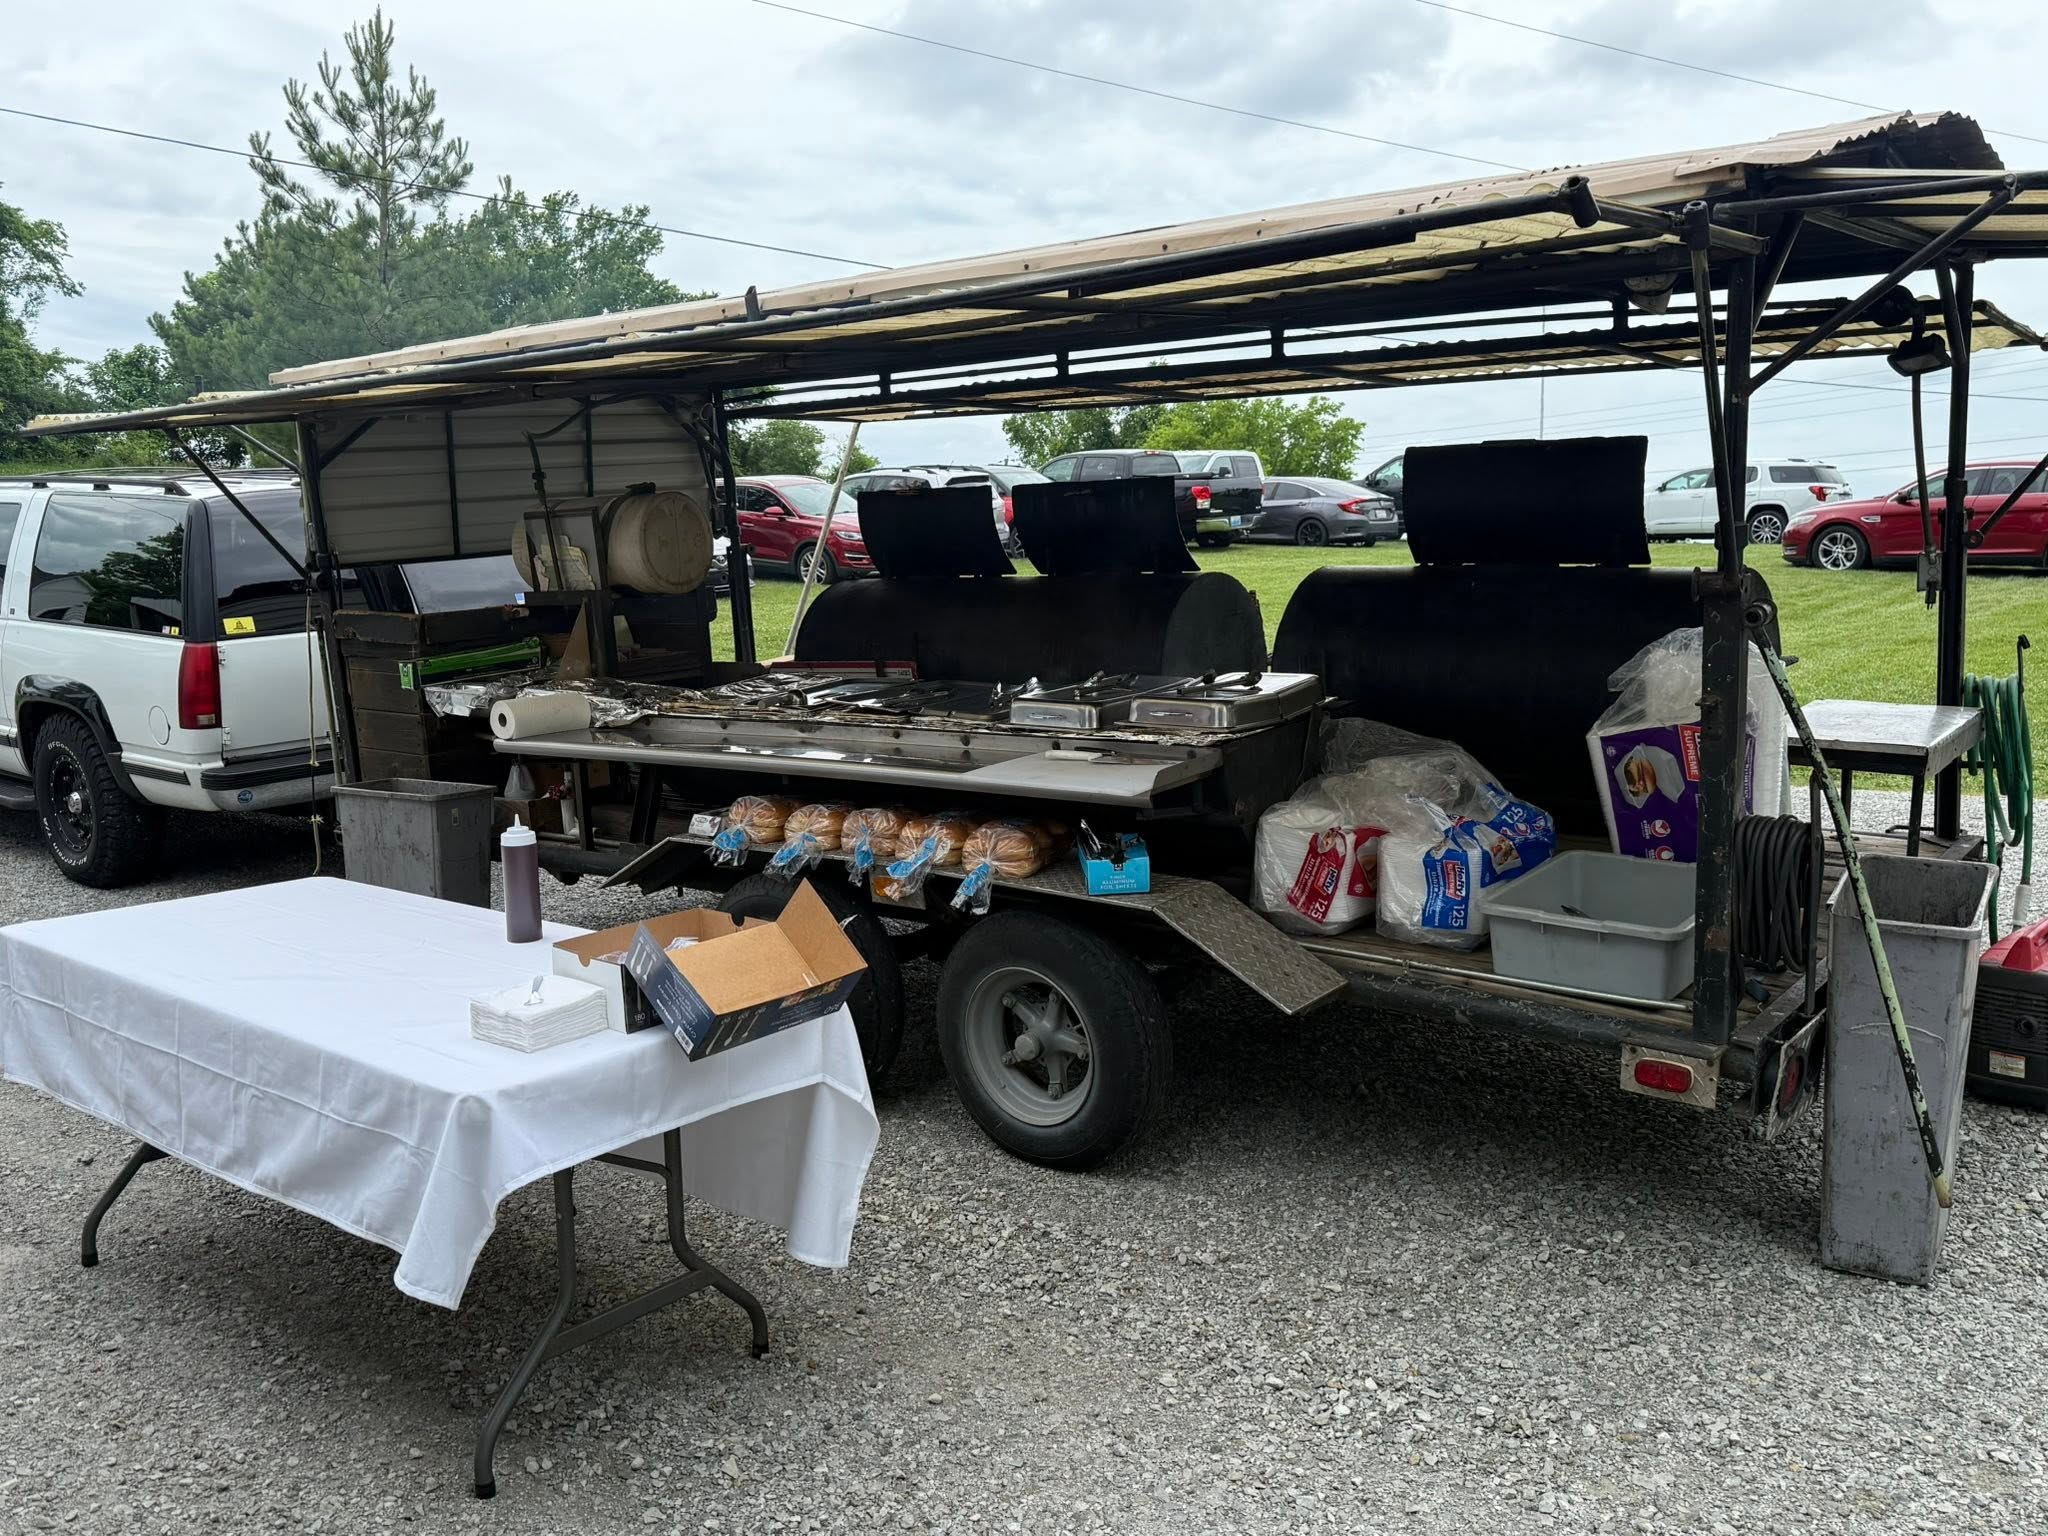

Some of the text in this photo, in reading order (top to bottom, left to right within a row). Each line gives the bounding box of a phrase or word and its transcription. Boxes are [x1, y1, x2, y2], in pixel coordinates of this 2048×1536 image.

[1684, 730, 1699, 775] SUPREME
[1502, 806, 1524, 823] 125
[1456, 866, 1465, 896] Hefty
[1311, 898, 1328, 919] 125
[1452, 904, 1465, 927] 125
